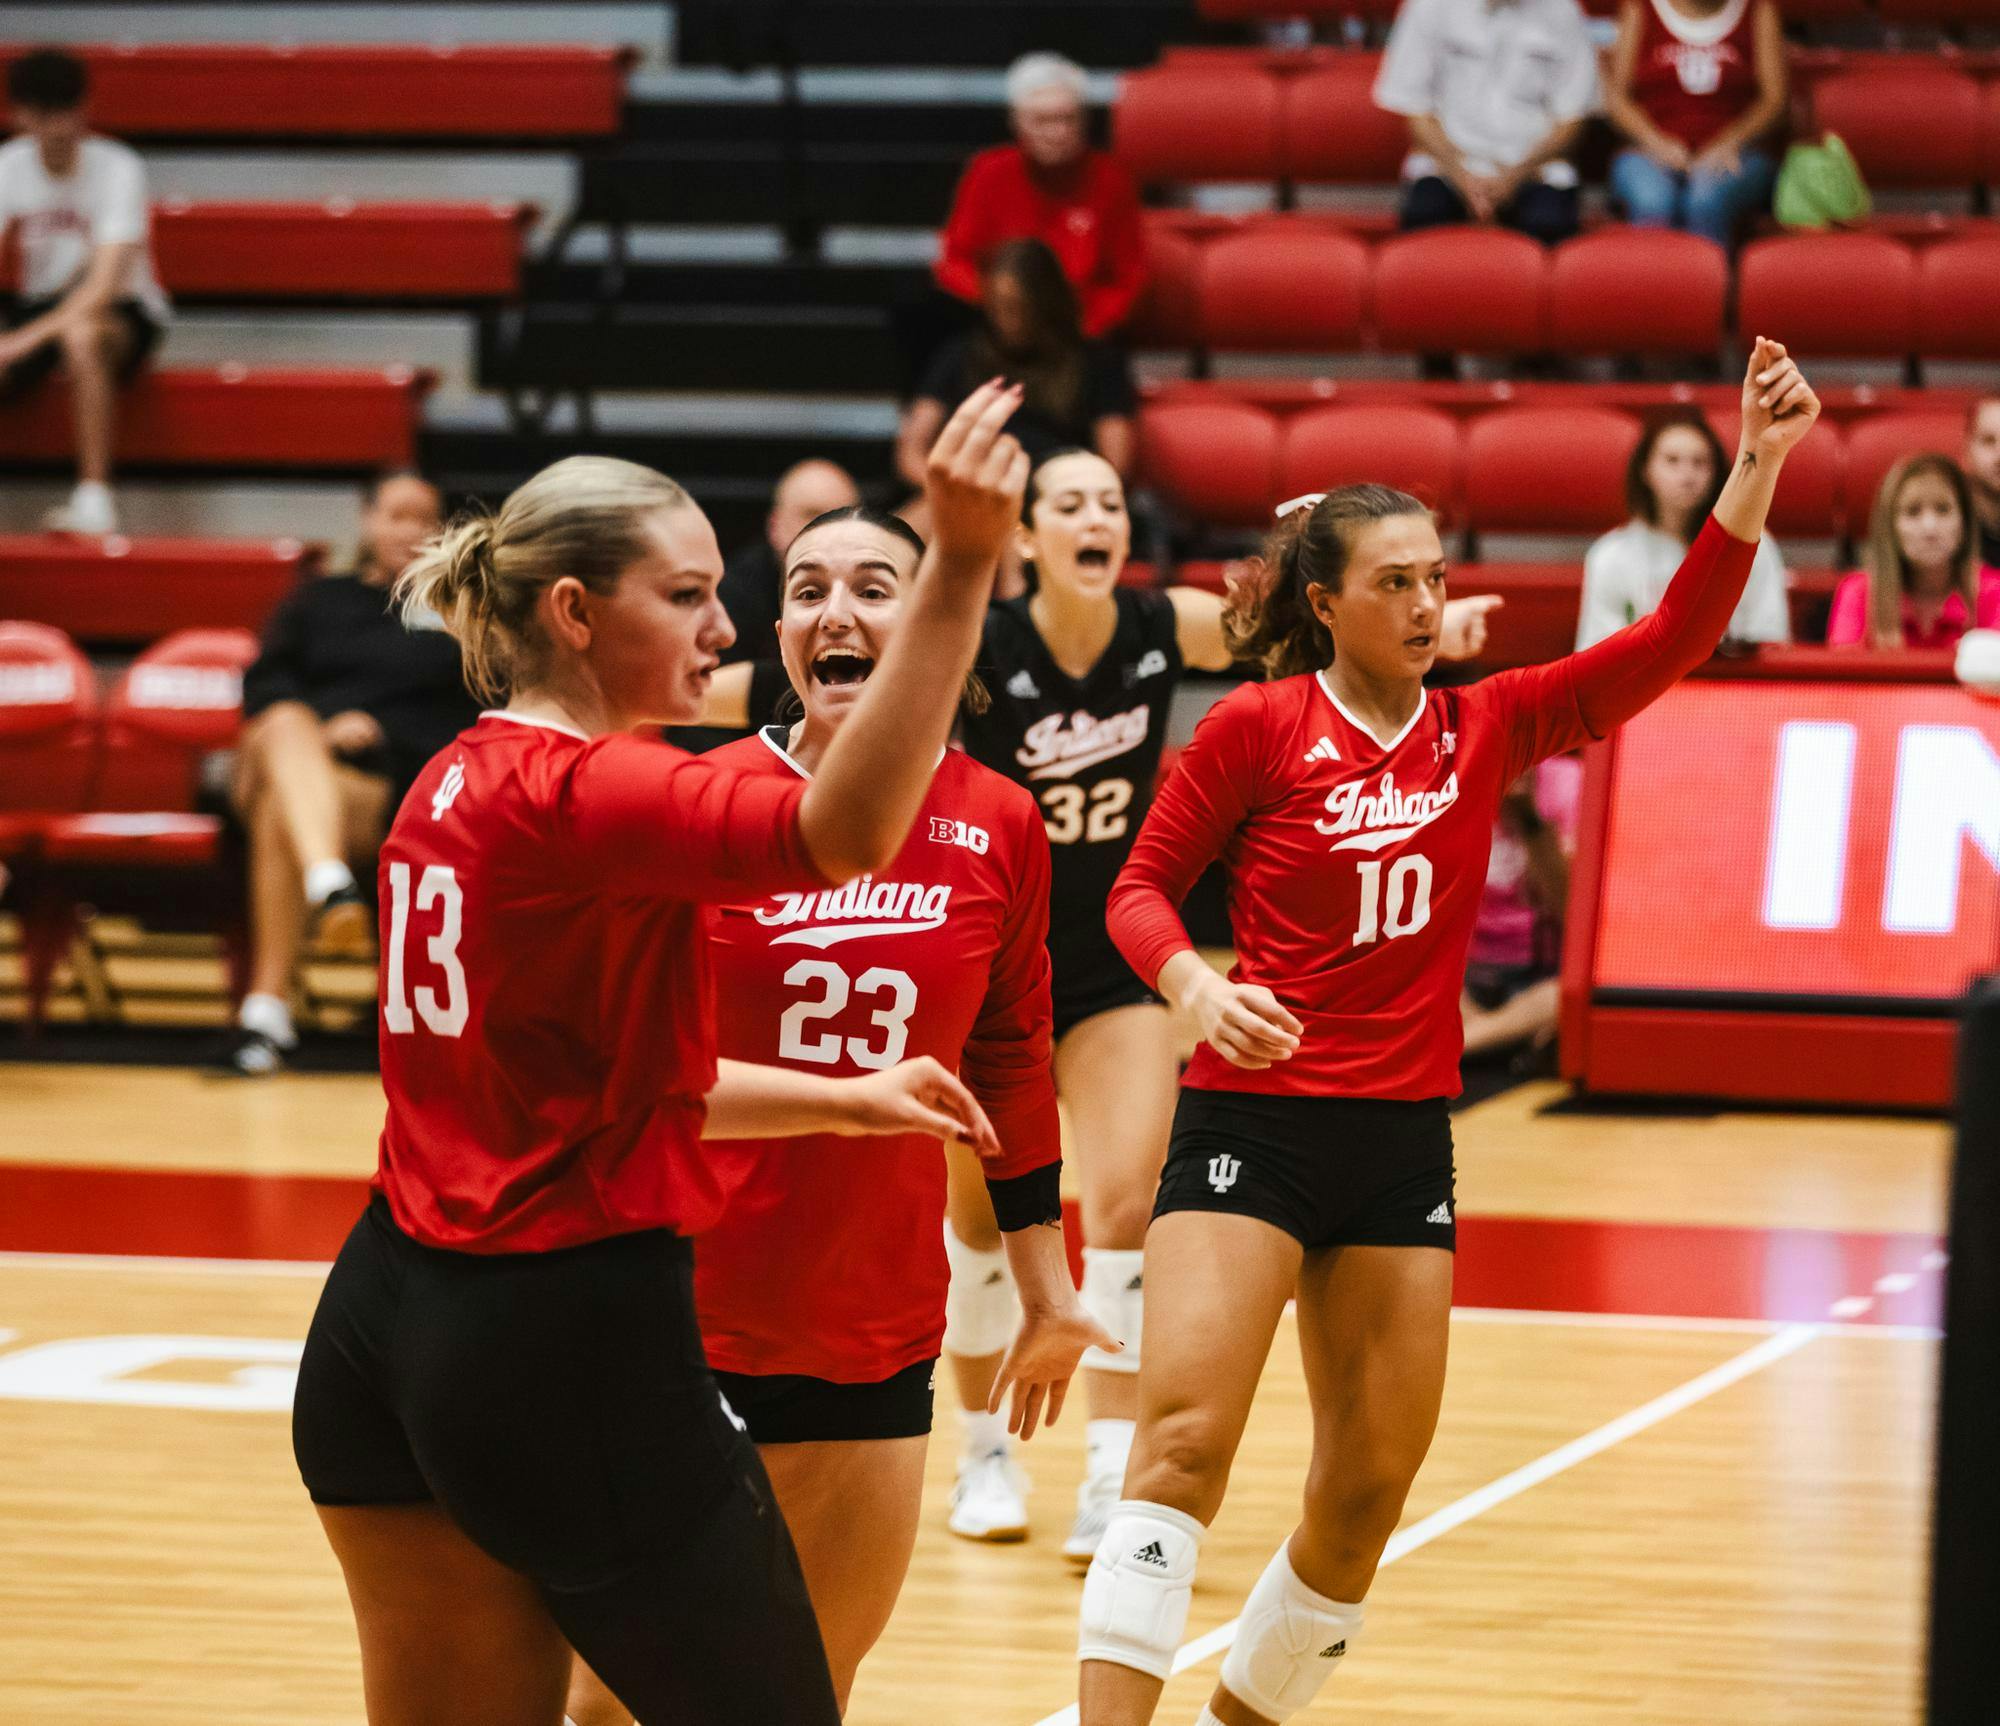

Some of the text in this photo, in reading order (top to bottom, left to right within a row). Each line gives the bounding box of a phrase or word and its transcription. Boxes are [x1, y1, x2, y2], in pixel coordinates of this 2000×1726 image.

[1015, 704, 1149, 770] Indiana
[1041, 778, 1134, 845] 32
[1314, 771, 1459, 836] Indiana
[753, 873, 953, 927] Indiana
[1352, 853, 1433, 947] 10
[384, 862, 470, 1038] 13
[778, 959, 918, 1070] 23
